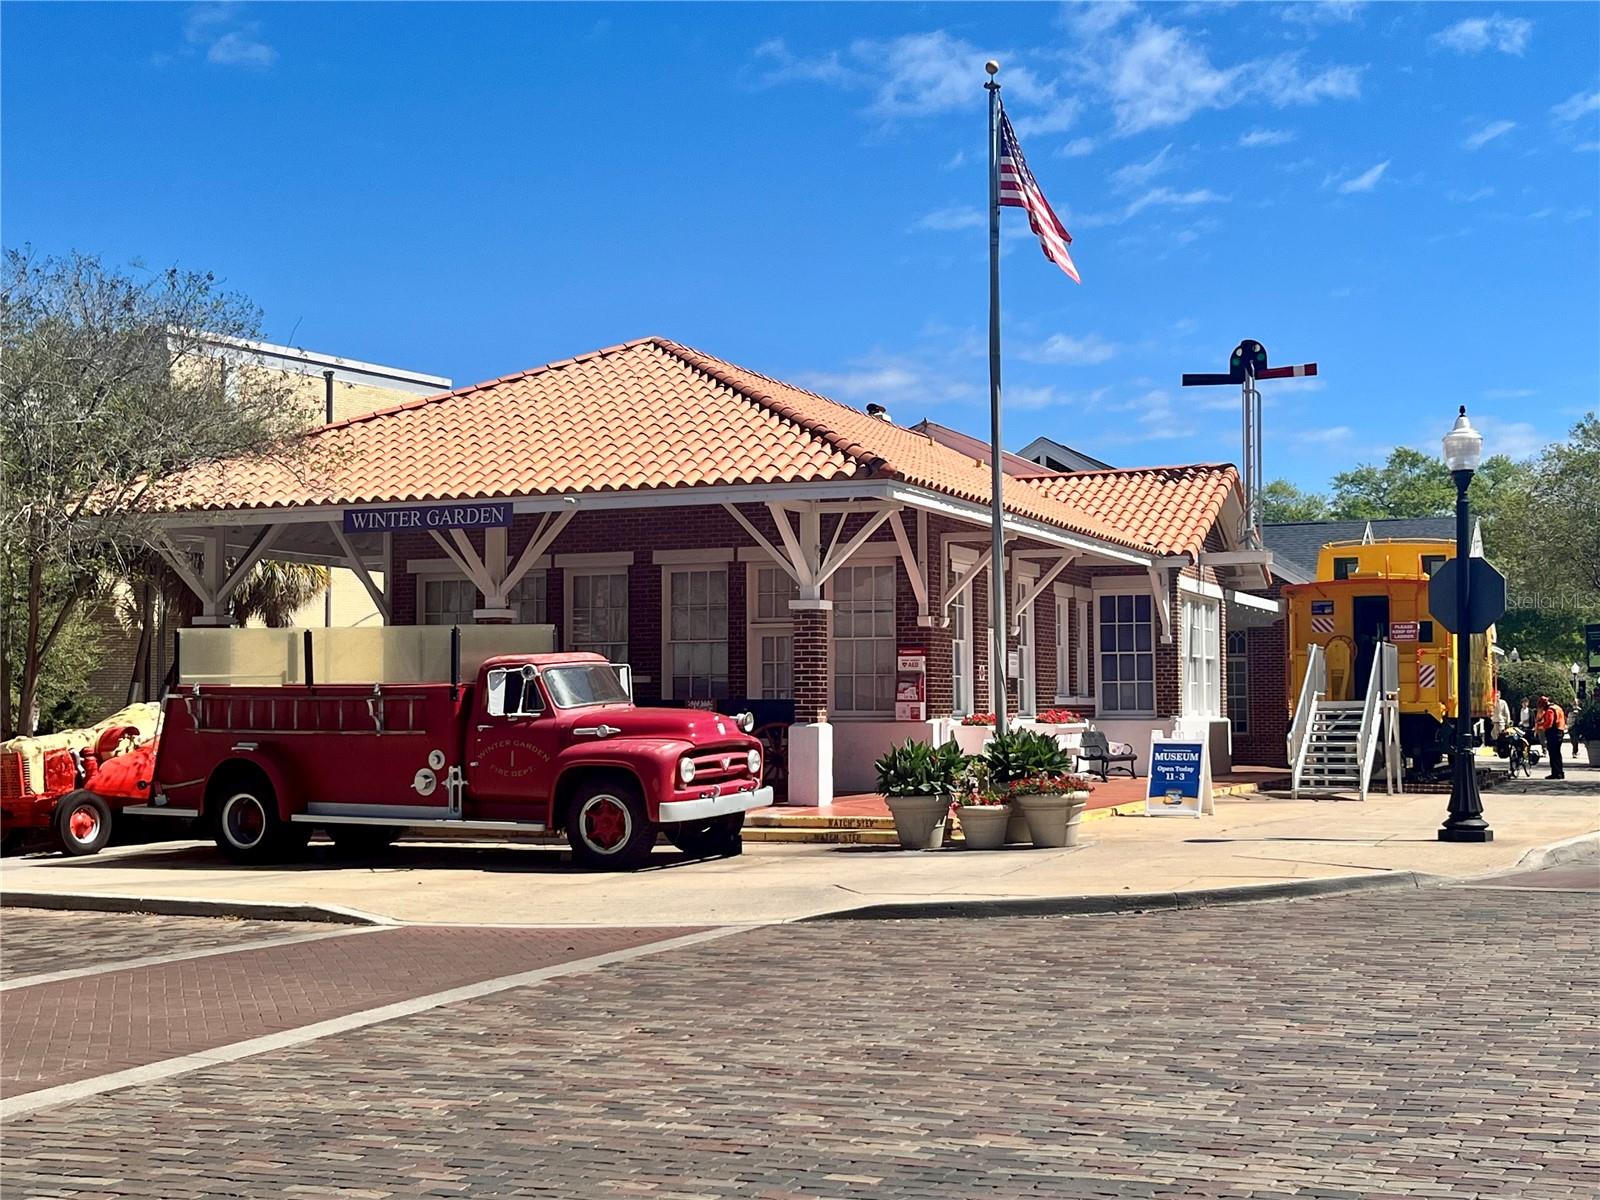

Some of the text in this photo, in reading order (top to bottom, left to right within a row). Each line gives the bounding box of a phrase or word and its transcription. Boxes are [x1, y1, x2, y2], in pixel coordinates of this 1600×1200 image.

[351, 506, 505, 529] WINTER GARDEN
[477, 739, 551, 762] WINTER GARDEN
[1154, 752, 1199, 761] MUSEUM
[489, 763, 509, 777] FIRE
[1157, 765, 1195, 773] Open Today
[828, 818, 853, 828] WATCH
